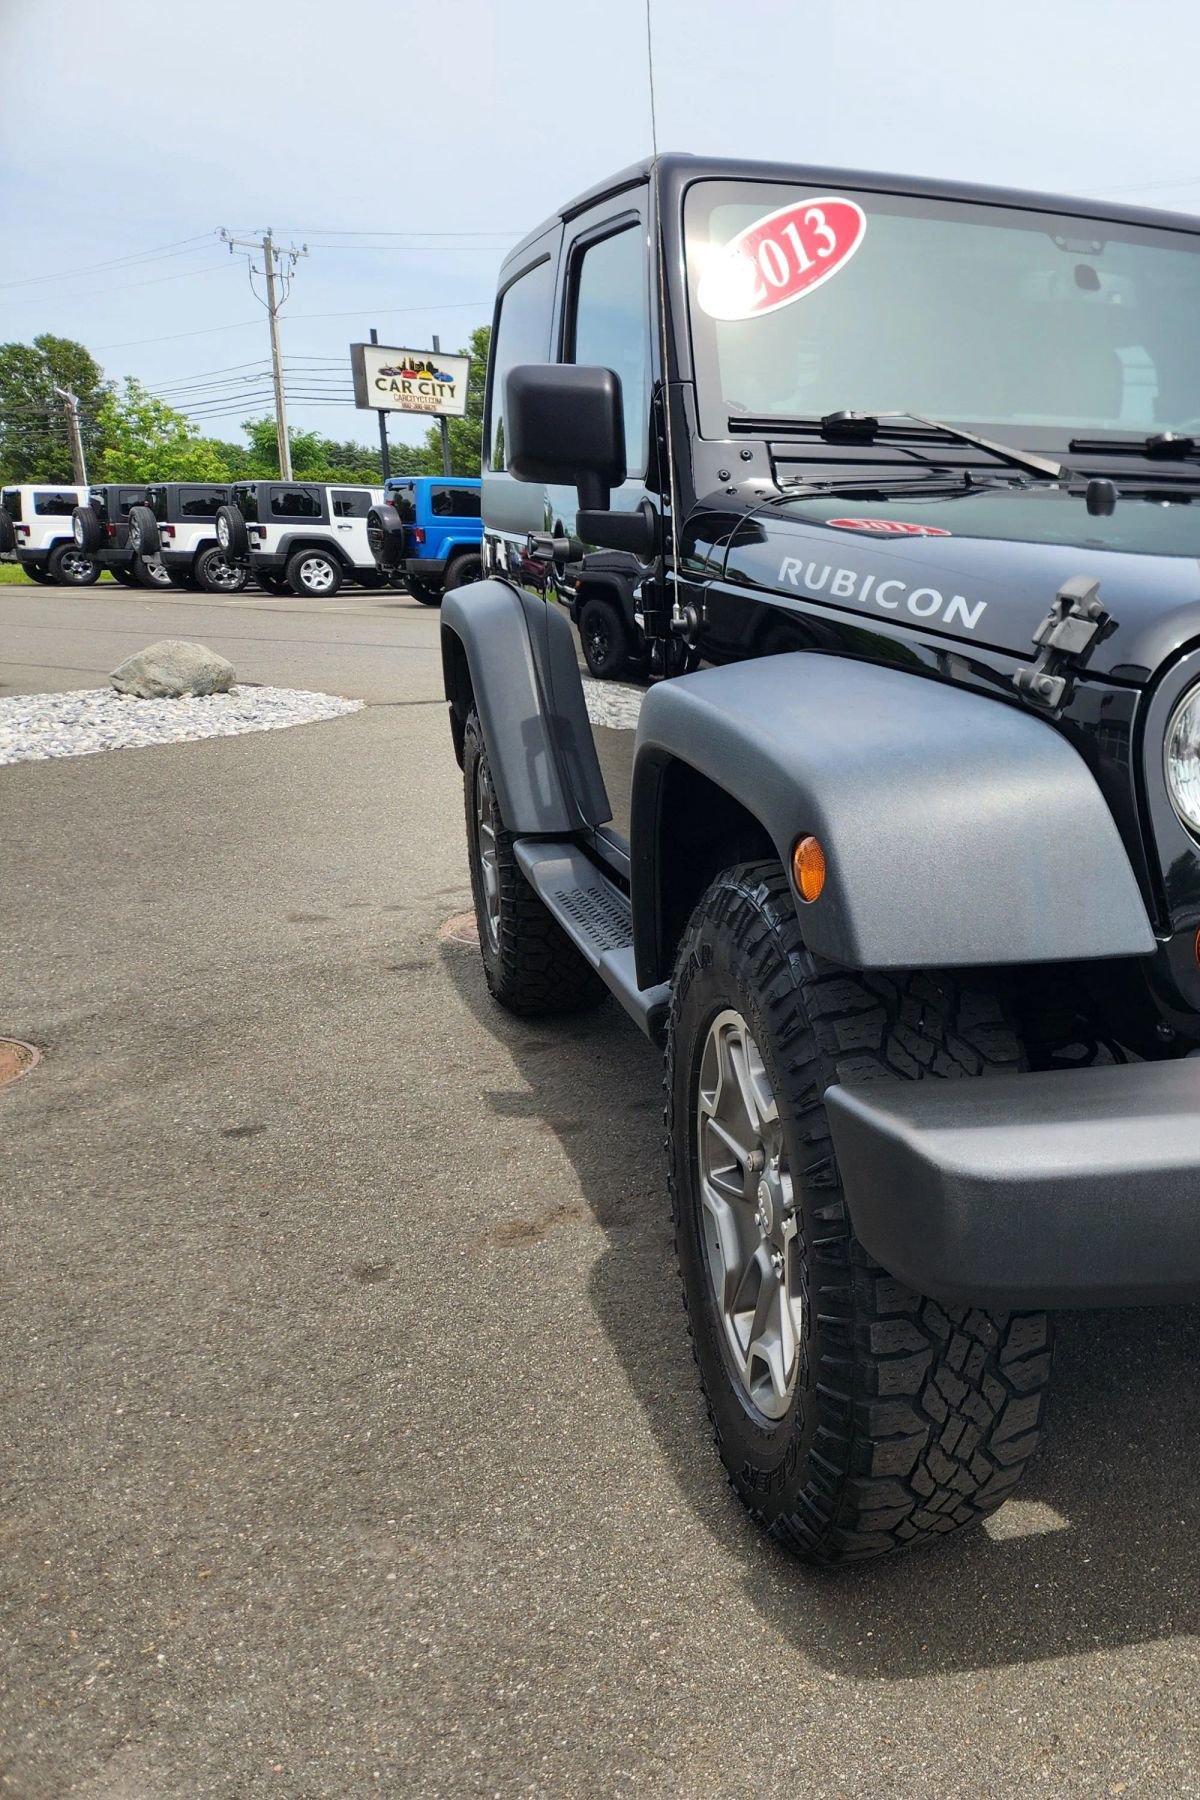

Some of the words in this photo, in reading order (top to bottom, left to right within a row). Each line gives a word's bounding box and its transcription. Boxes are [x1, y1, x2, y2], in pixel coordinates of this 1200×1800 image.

[374, 378, 412, 394] CAR
[418, 382, 456, 398] CITY
[778, 556, 988, 630] RUBICON
